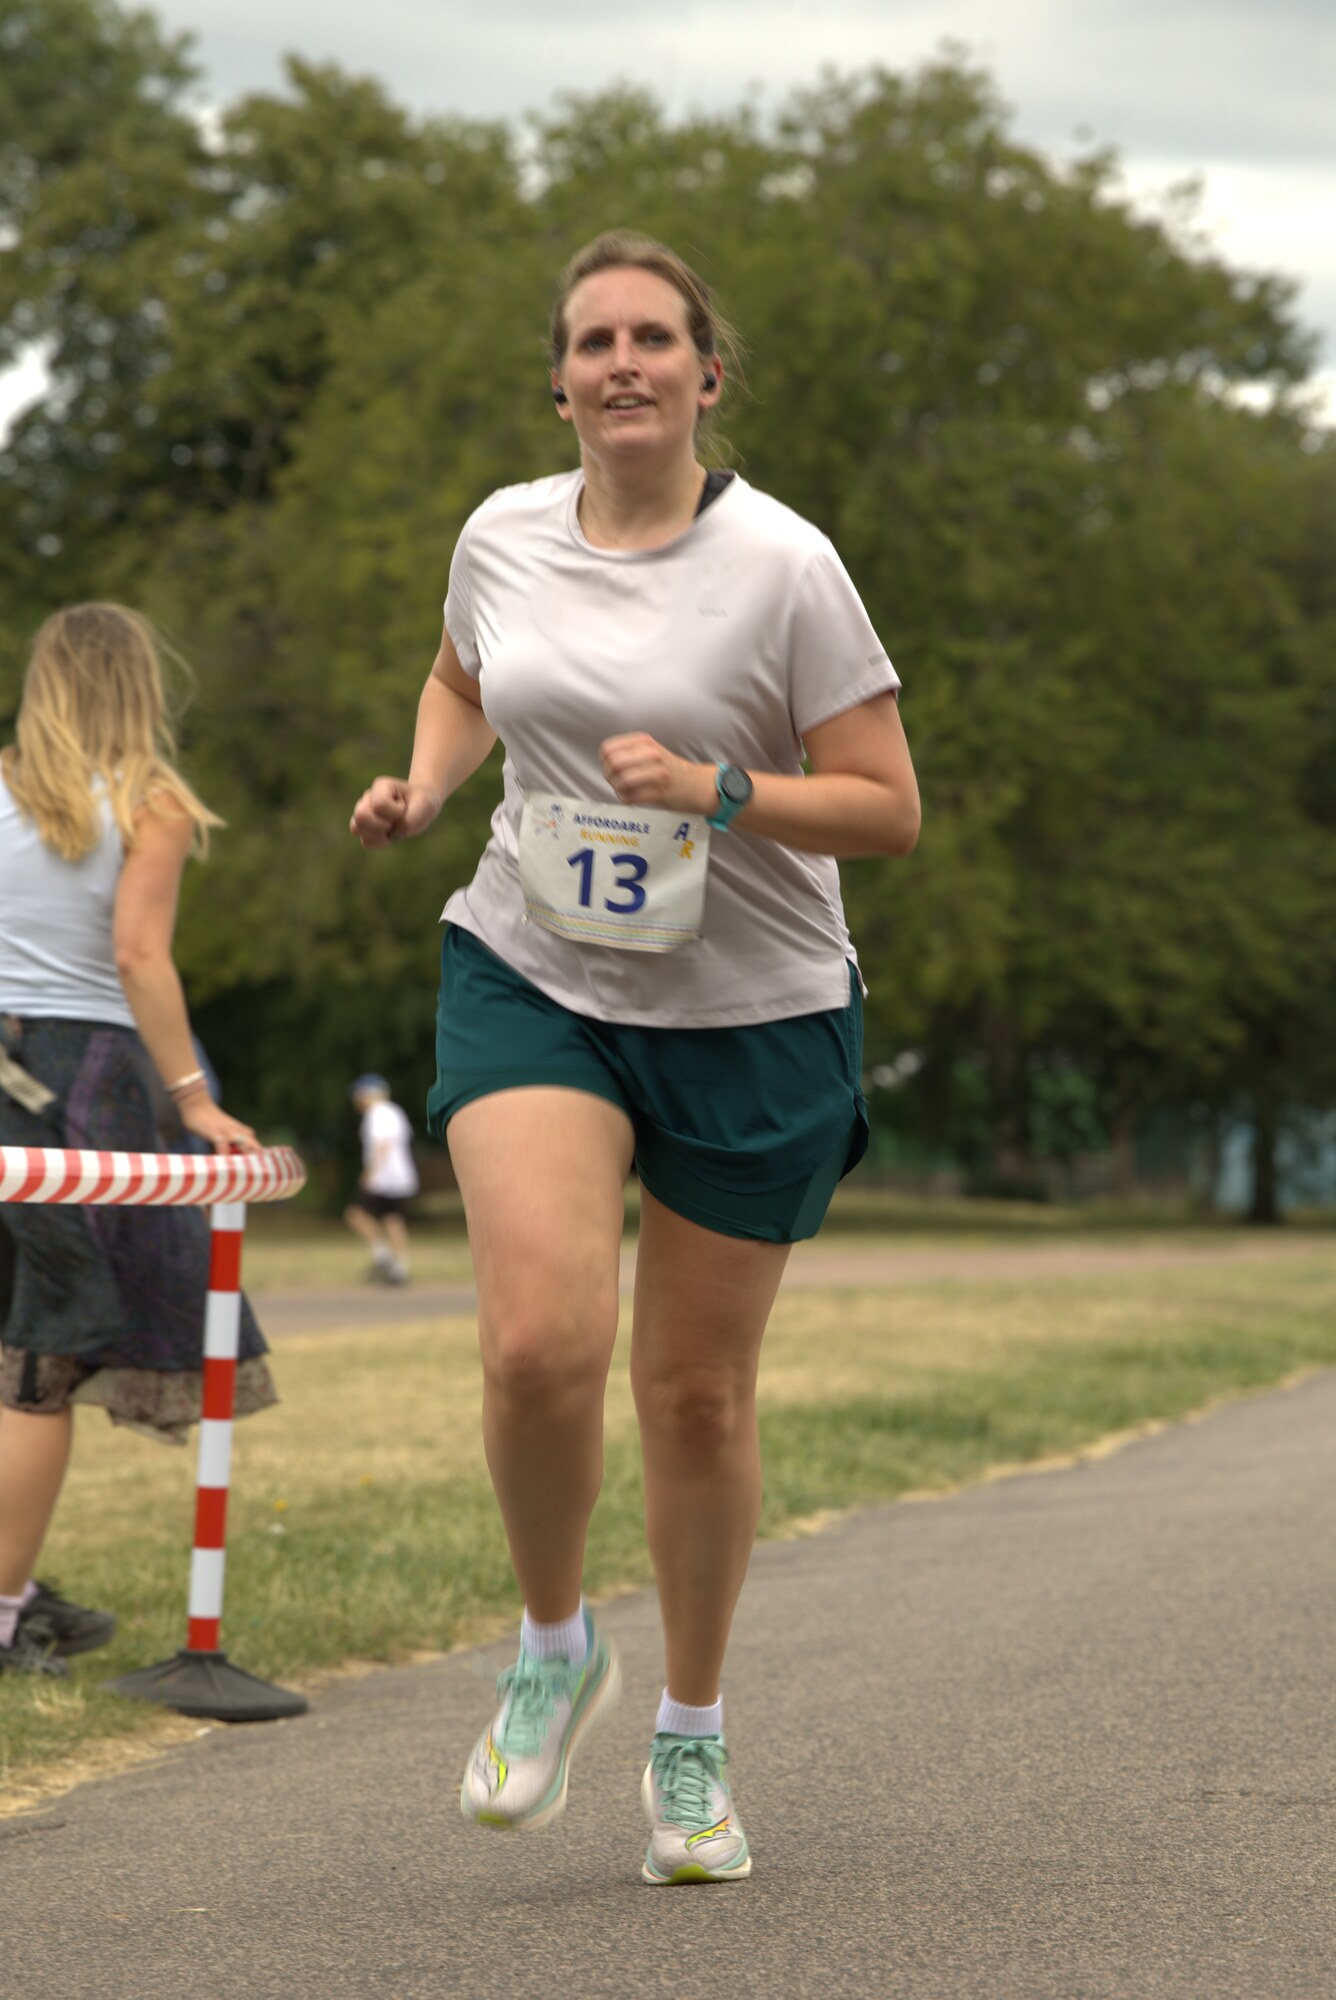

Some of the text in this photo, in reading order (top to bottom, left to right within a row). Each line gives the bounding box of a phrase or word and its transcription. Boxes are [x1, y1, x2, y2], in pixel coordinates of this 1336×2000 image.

[573, 813, 651, 834] AFFORDABLE
[673, 822, 690, 840] A
[580, 830, 640, 848] RUNNING
[679, 840, 695, 859] R
[567, 847, 649, 914] 13
